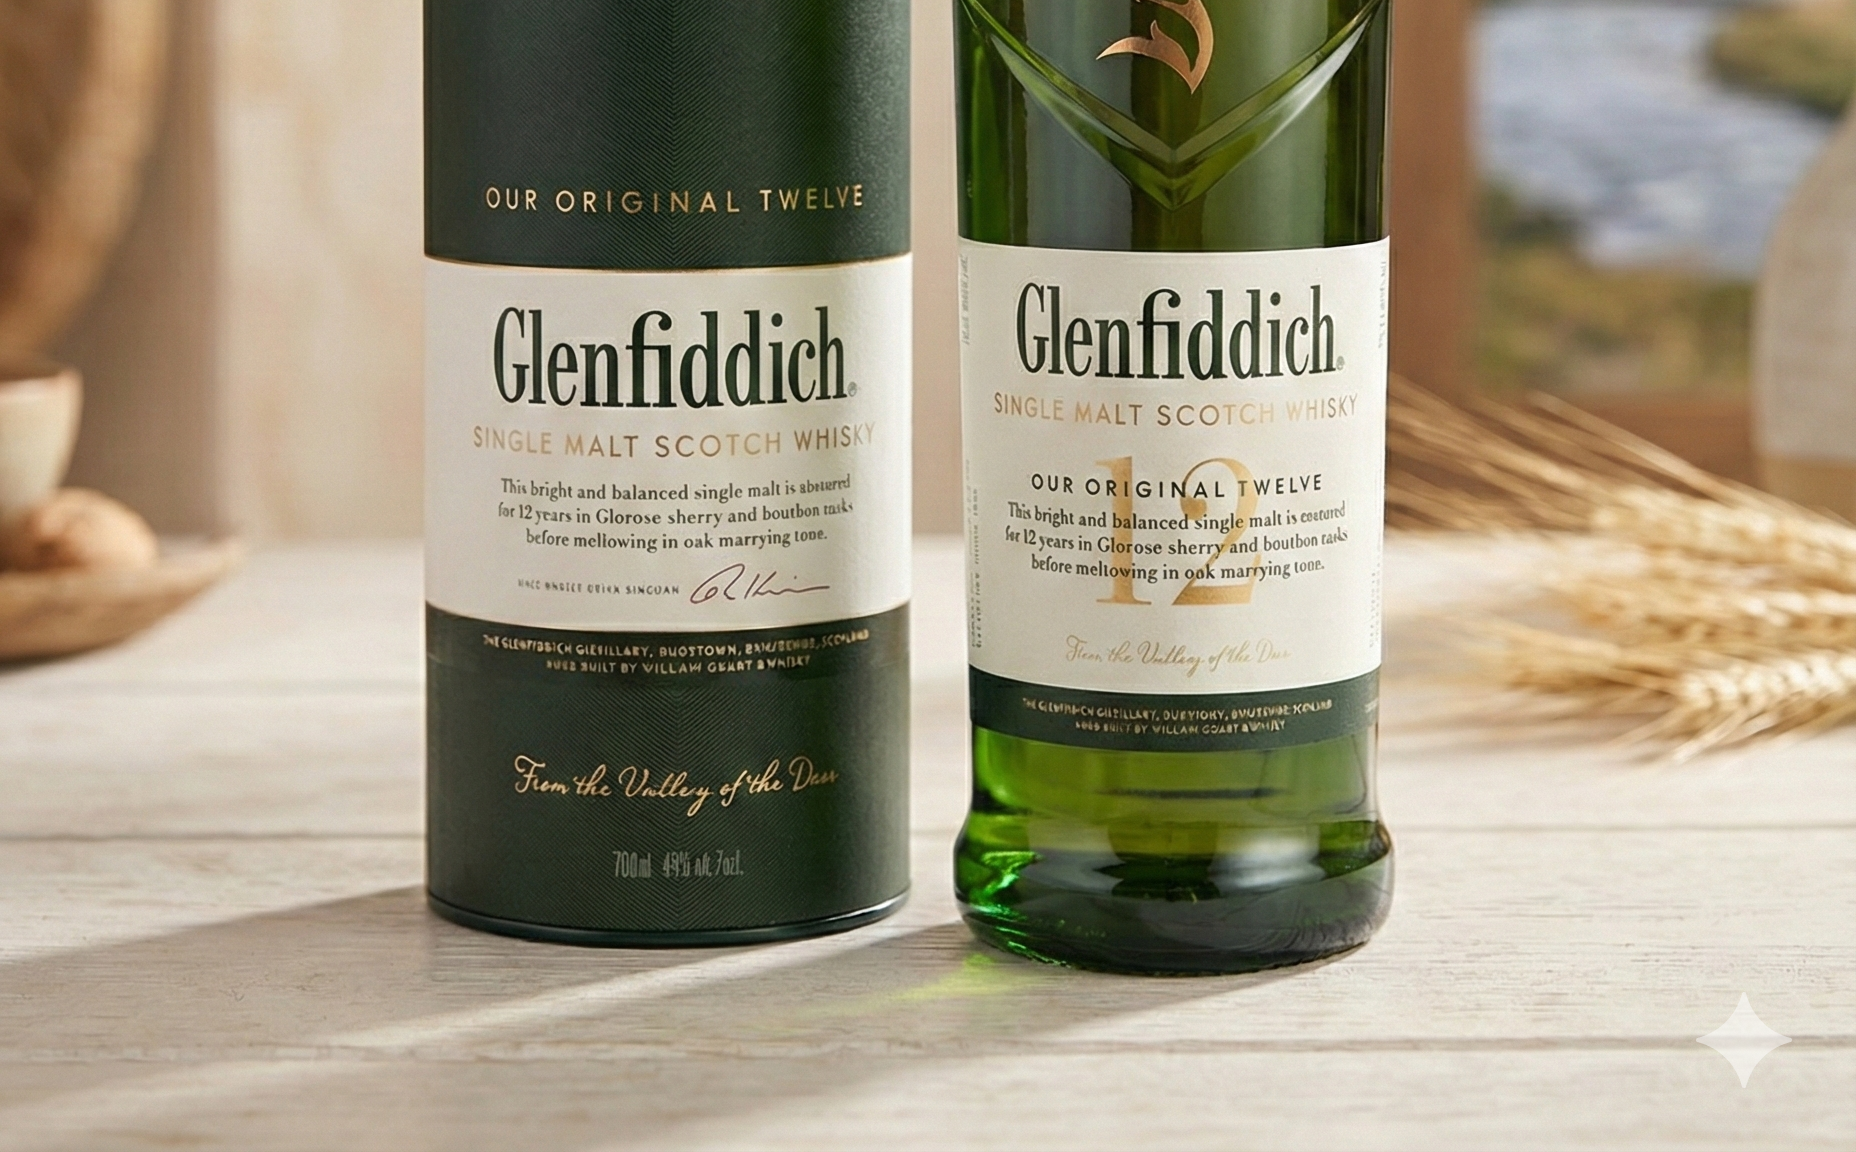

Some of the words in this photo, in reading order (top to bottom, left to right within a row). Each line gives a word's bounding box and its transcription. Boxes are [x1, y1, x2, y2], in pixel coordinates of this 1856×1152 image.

[486, 187, 537, 211] OUR
[555, 190, 740, 213] ORIGINAL
[759, 184, 863, 211] TWELVE
[1016, 282, 1337, 380] Glenfiddich
[493, 306, 849, 409] Glenfiddich
[994, 392, 1063, 421] SINGLE
[1074, 404, 1144, 425] MALT
[1157, 404, 1274, 426] SCOTCH
[1286, 393, 1358, 423] WHISKY
[473, 425, 553, 455] SINGLE
[564, 434, 639, 458] MALT
[654, 432, 781, 458] SCOTCH
[794, 421, 876, 452] WHISKY
[501, 478, 527, 494] This
[531, 480, 573, 502] bright
[577, 484, 606, 500] and
[612, 484, 688, 501] balanced
[694, 483, 743, 504] single
[747, 480, 781, 498] malt
[785, 480, 797, 495] is
[1031, 473, 1074, 494] OUR
[1085, 478, 1225, 499] ORIGINAL
[1238, 473, 1322, 497] TWELVE
[519, 504, 533, 520] 12
[535, 509, 572, 525] years
[576, 508, 591, 524] in
[596, 508, 662, 525] Glorose
[667, 509, 723, 529] sherry
[727, 506, 757, 523] and
[1008, 501, 1032, 519] This
[1035, 505, 1074, 528] bright
[1078, 511, 1107, 528] and
[1113, 513, 1189, 530] balanced
[1194, 513, 1244, 534] single
[1249, 510, 1282, 528] malt
[1286, 510, 1298, 525] is
[1095, 456, 1261, 606] 12
[526, 528, 570, 547] before
[662, 533, 678, 549] in
[683, 532, 714, 549] oak
[719, 529, 791, 550] marrying
[1024, 529, 1037, 545] 12
[1039, 535, 1074, 551] years
[1078, 535, 1092, 552] in
[1097, 536, 1162, 555] Glorose
[1168, 539, 1224, 559] sherry
[1229, 536, 1258, 554] and
[1032, 553, 1072, 574] before
[1162, 563, 1179, 580] in
[1221, 561, 1291, 581] marrying
[573, 764, 612, 797] the
[719, 769, 747, 807] of
